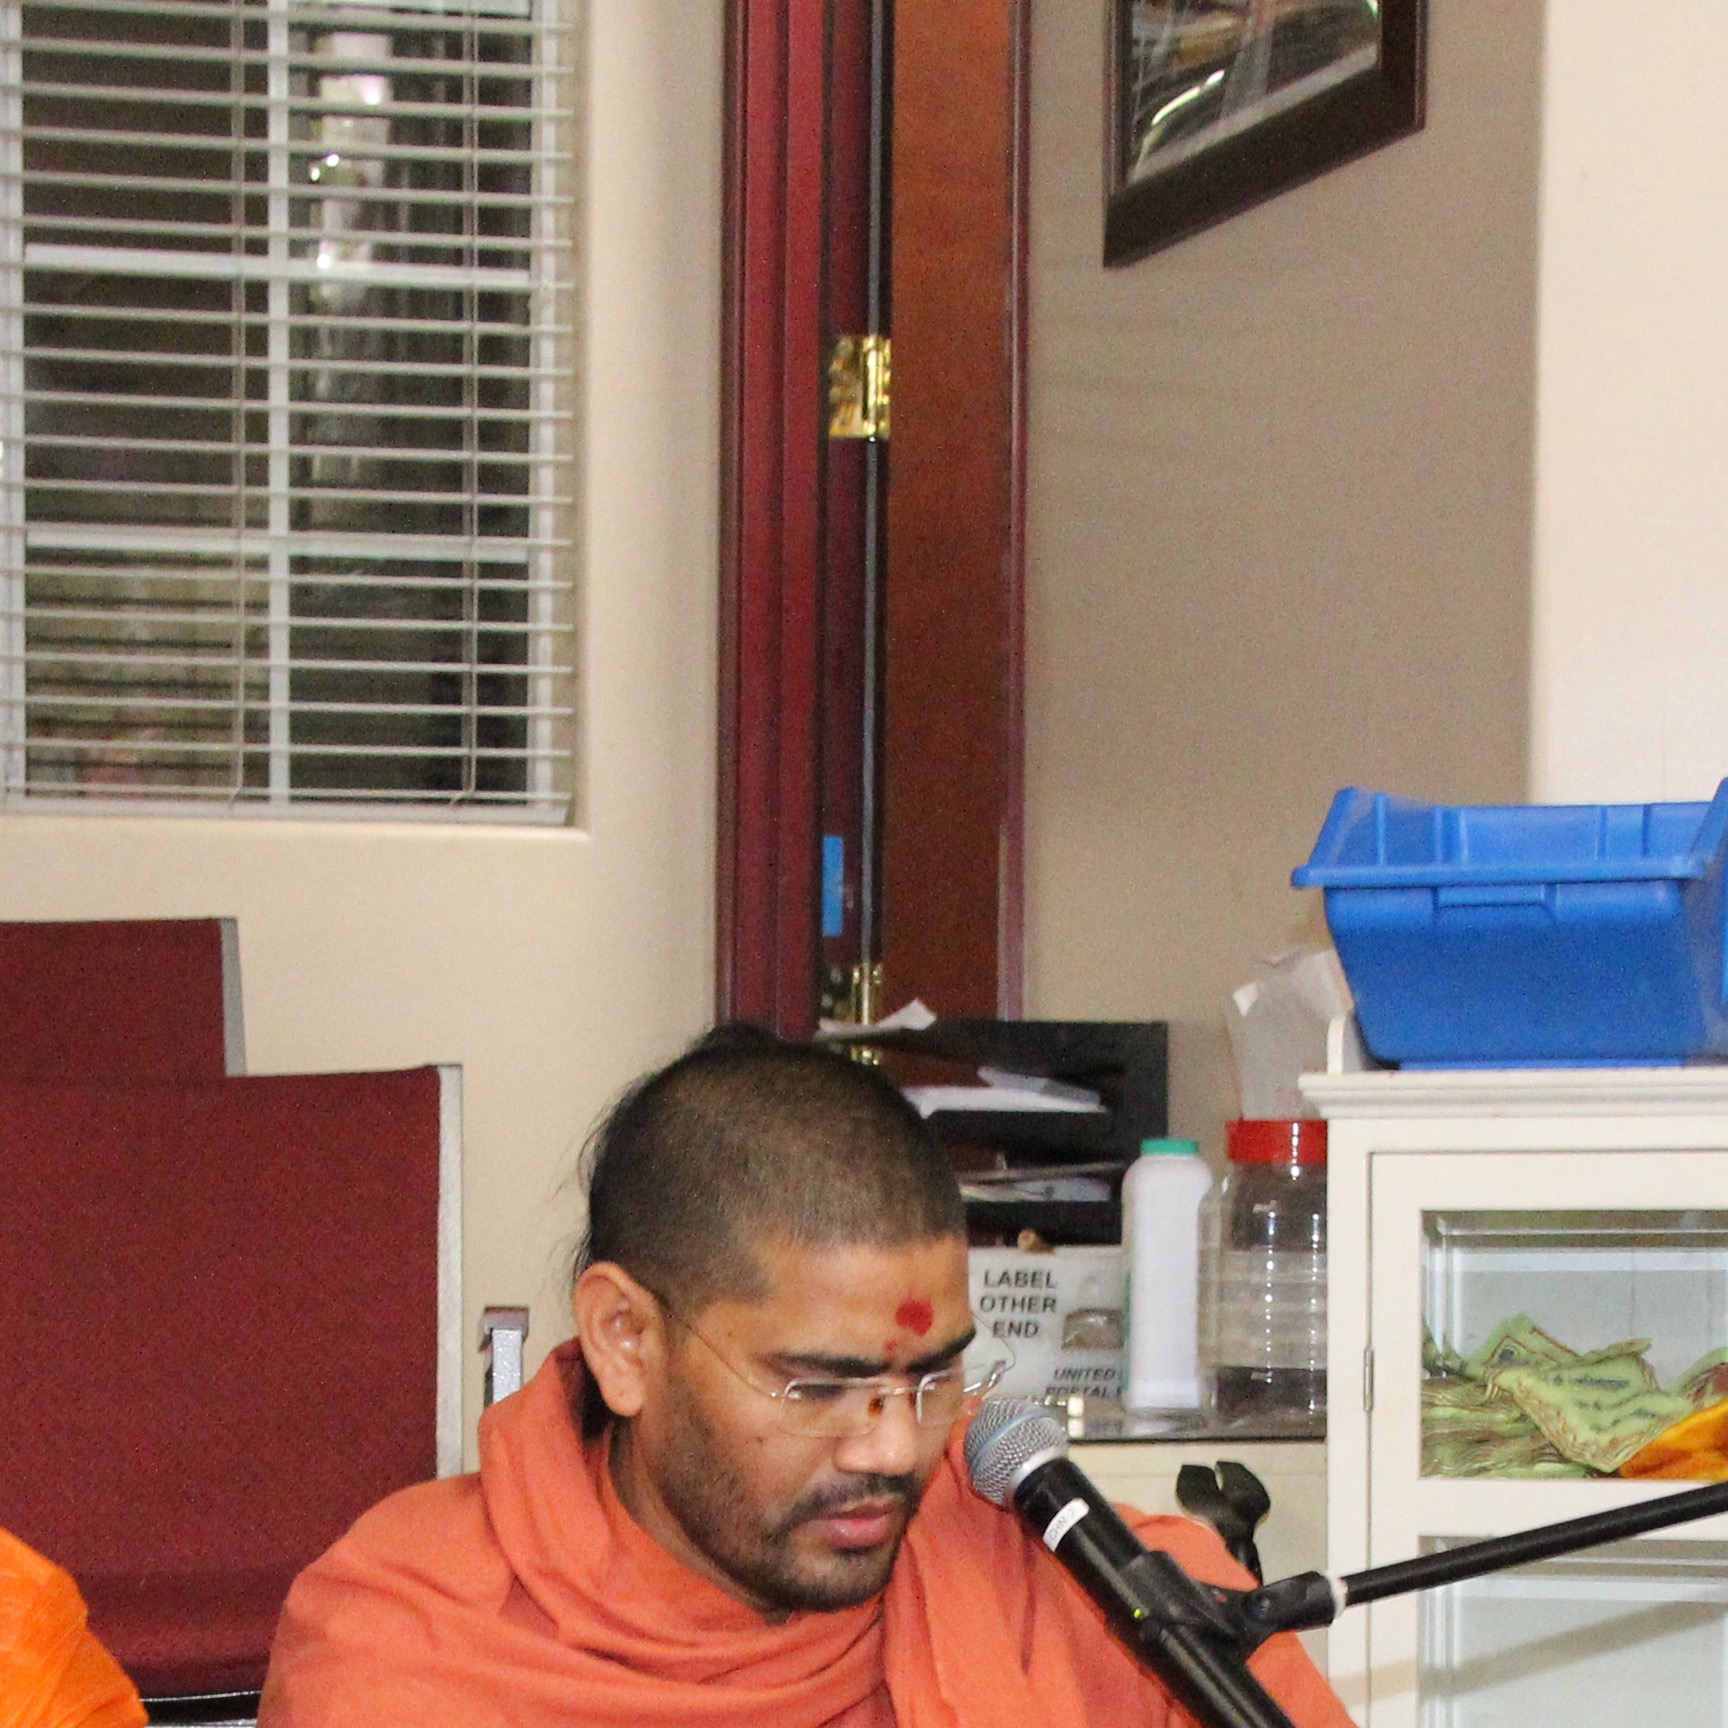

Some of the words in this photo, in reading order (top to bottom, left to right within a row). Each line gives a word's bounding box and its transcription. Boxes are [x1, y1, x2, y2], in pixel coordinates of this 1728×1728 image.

[983, 1269, 1058, 1289] LABEL
[979, 1296, 1057, 1314] OTHER
[992, 1320, 1040, 1339] END
[1053, 1368, 1116, 1381] UNITED
